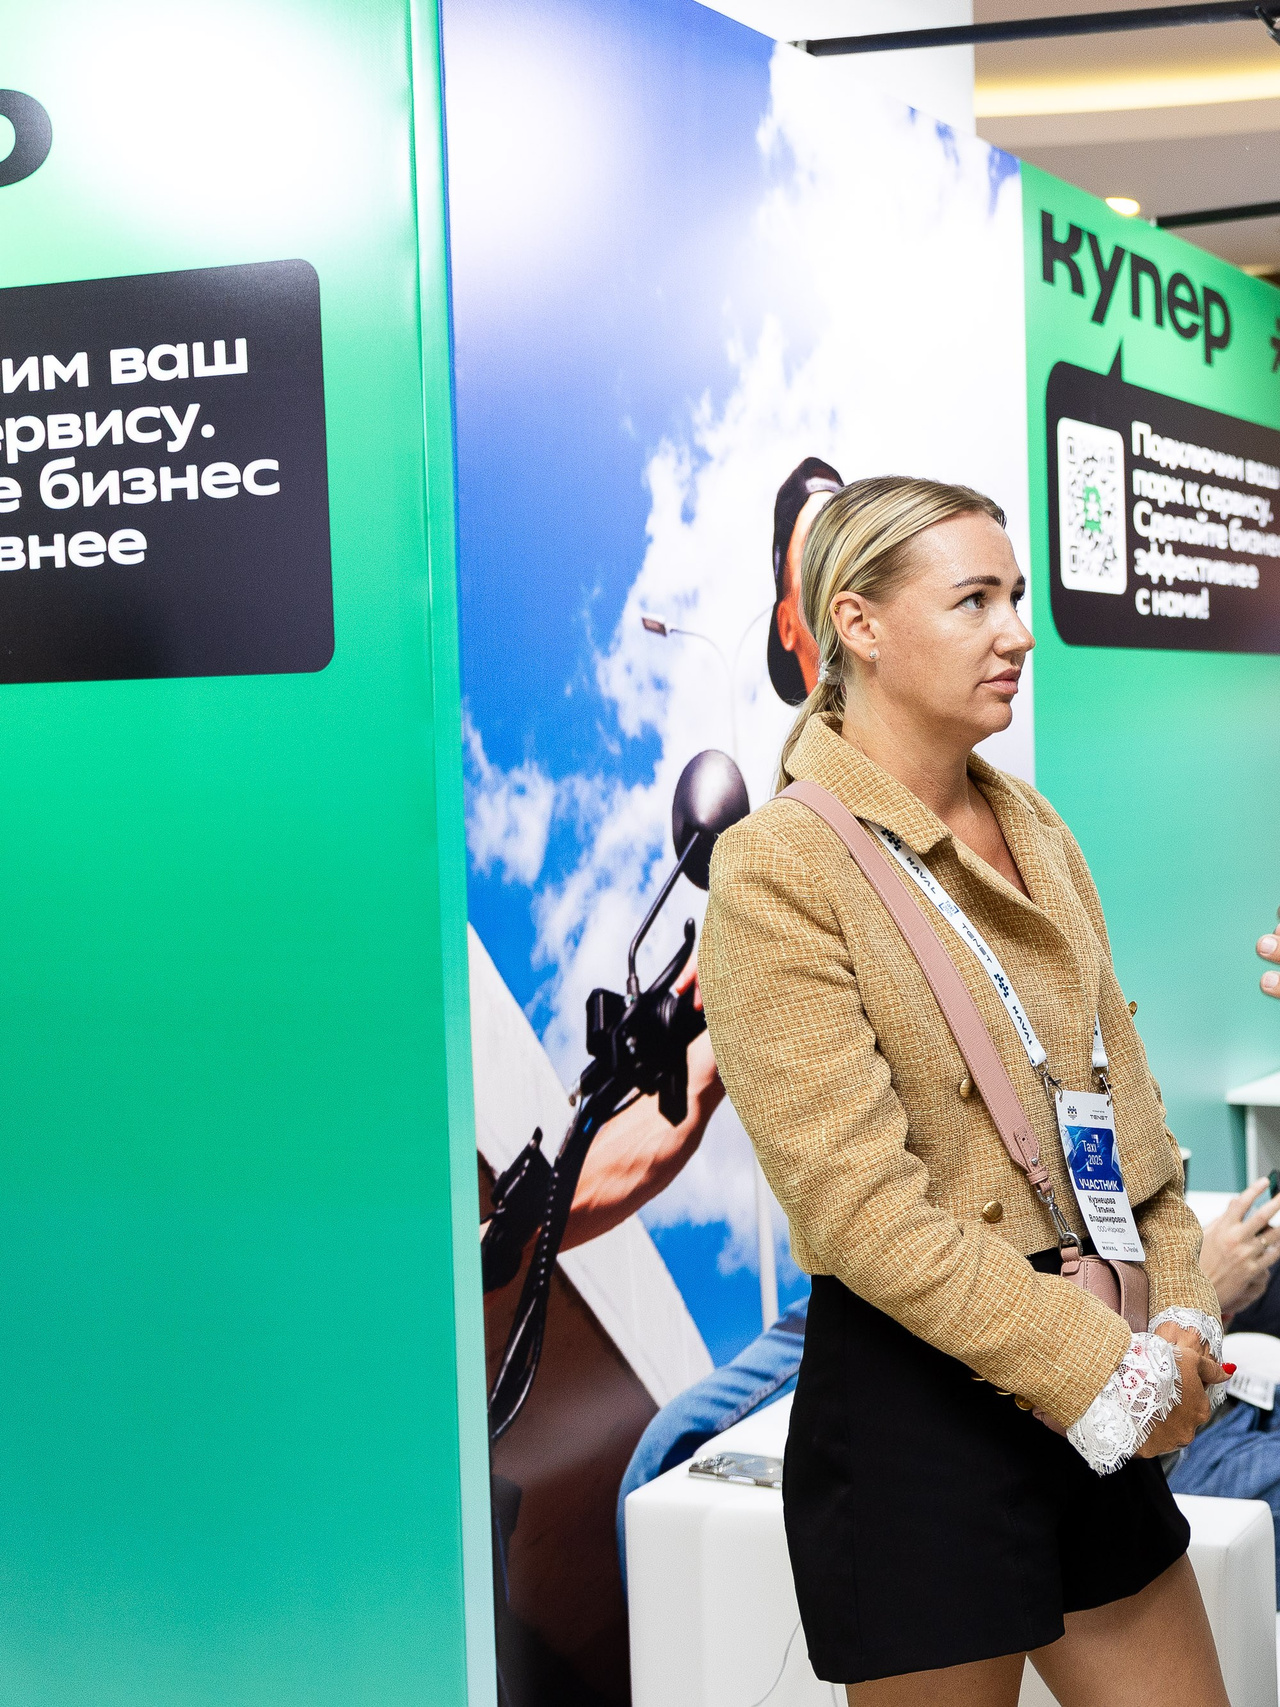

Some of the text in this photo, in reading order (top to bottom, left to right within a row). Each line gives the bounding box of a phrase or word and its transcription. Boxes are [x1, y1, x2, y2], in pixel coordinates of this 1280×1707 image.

[1040, 209, 1232, 366] купер
[110, 338, 248, 385] ваш
[0, 403, 215, 464] рвису.
[1131, 420, 1280, 490] Подключим ваш
[39, 456, 280, 510] бизнес
[1132, 468, 1184, 508] парк
[1184, 480, 1200, 508] к
[1133, 500, 1228, 549] Сделайте
[1133, 542, 1260, 589] эффективнее
[1135, 586, 1210, 620] с нами!
[906, 856, 936, 894] HAVAL
[1081, 1139, 1098, 1153] Taxi
[1088, 1154, 1104, 1166] 2025
[1078, 1178, 1120, 1191] УЧАСТНИК
